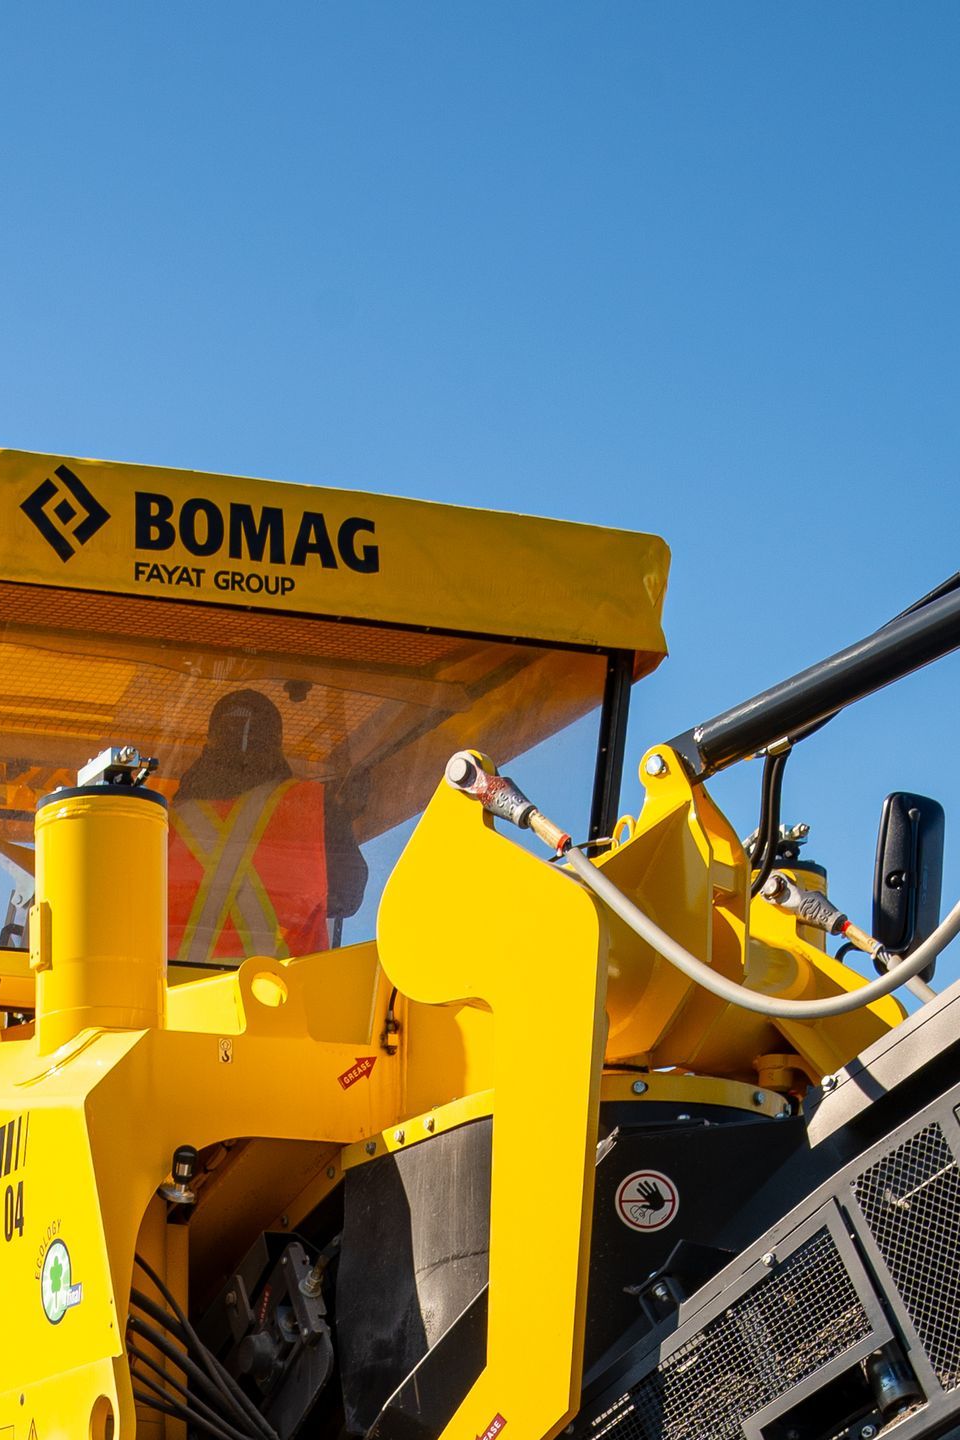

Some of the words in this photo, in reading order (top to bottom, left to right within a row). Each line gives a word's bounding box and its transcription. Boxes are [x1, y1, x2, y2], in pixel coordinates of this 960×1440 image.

[135, 491, 380, 574] BOMAG
[135, 562, 206, 588] FAYAT
[214, 570, 296, 596] GROUP
[343, 1060, 371, 1084] GREASE
[4, 1181, 25, 1243] 04
[34, 1218, 61, 1281] ECOLOGY
